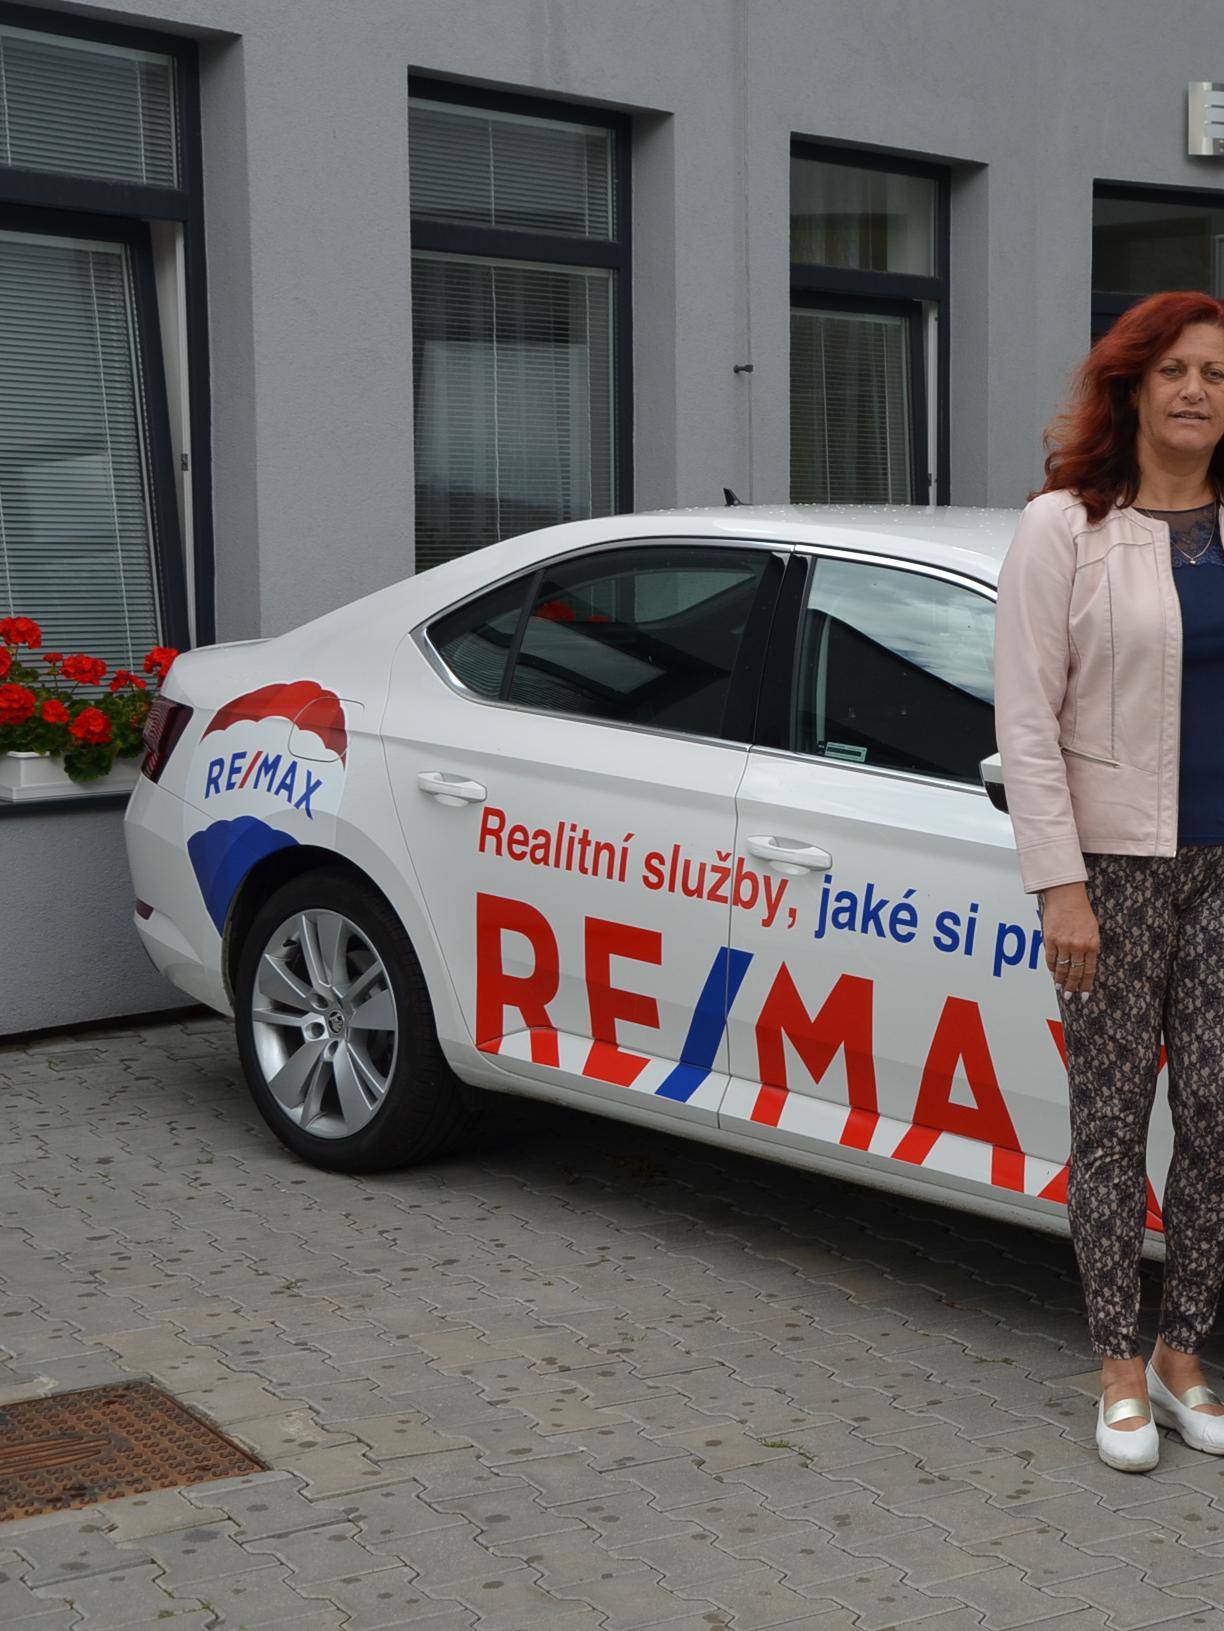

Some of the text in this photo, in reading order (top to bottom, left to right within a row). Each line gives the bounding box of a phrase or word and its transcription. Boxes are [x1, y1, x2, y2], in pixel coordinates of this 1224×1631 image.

[204, 751, 323, 820] RE/MAX
[478, 807, 634, 882] Realitní
[643, 844, 797, 929] služby,
[815, 874, 918, 944] jaké
[933, 902, 979, 956] si
[475, 892, 1168, 1234] RE/MA
